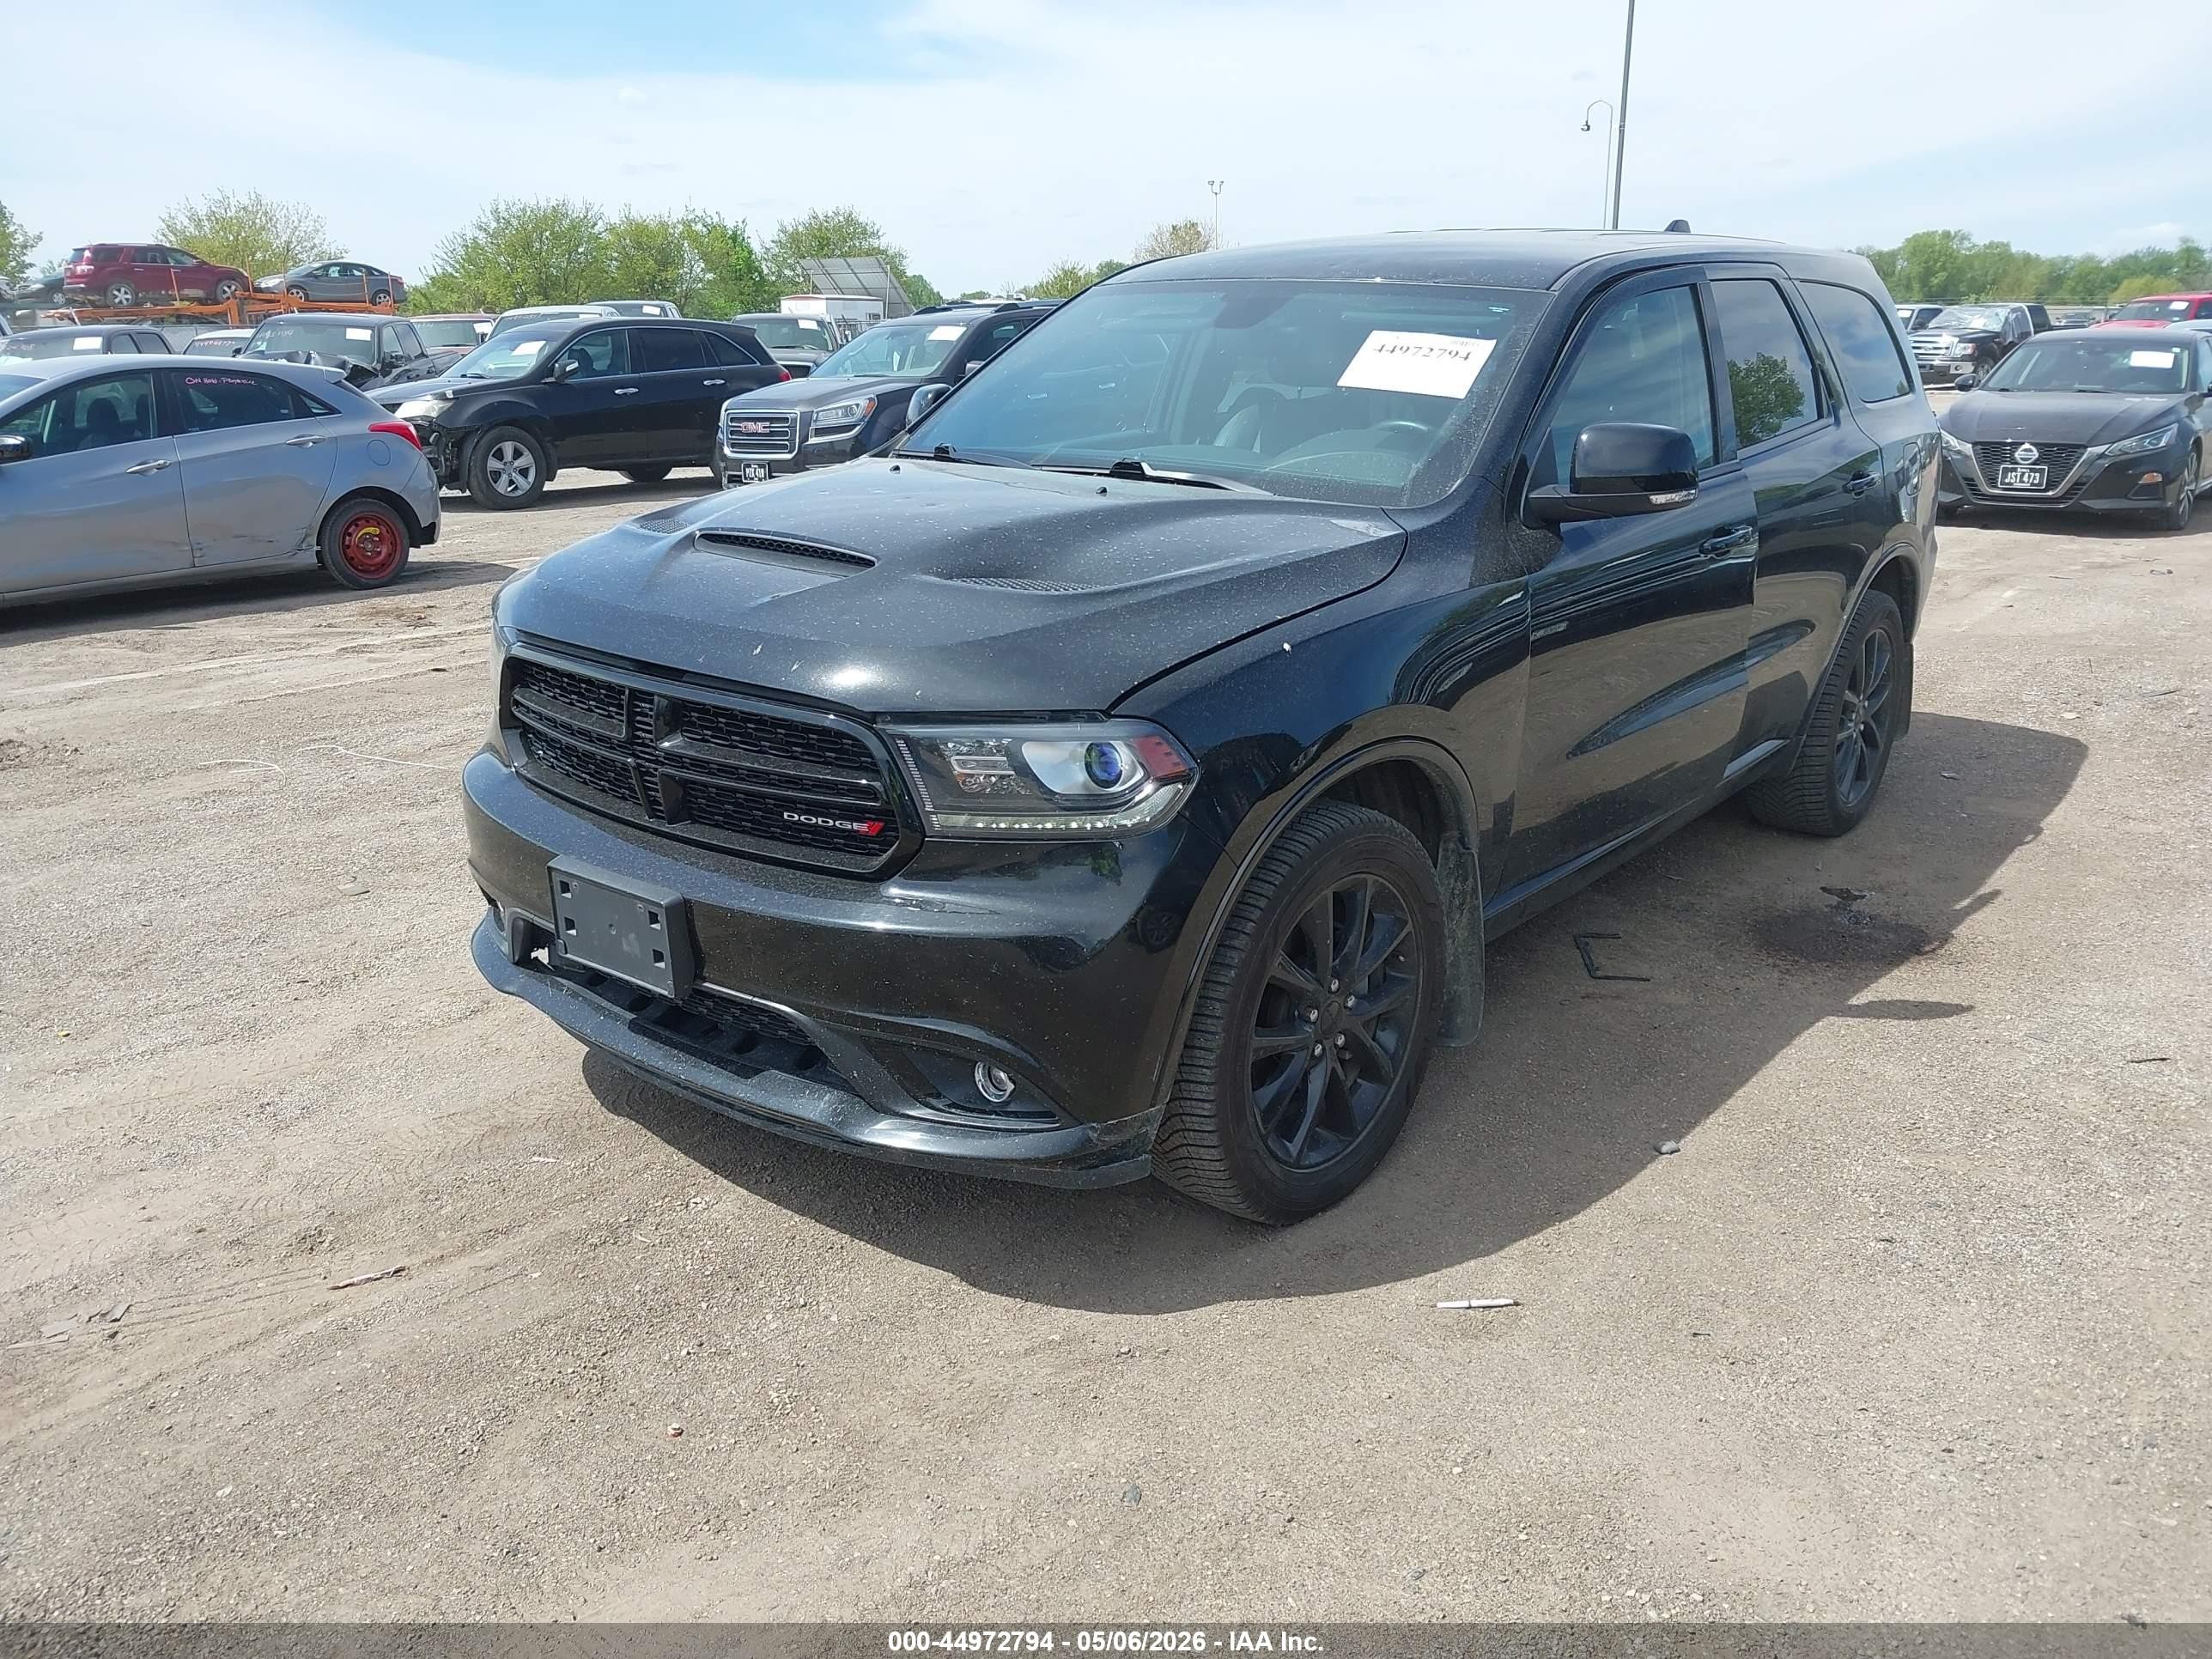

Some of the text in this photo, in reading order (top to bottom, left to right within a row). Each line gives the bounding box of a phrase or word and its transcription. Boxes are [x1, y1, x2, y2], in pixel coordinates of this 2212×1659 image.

[1373, 343, 1472, 362] 44972794
[741, 422, 770, 434] GMC
[2004, 471, 2040, 484] JST 473
[783, 811, 869, 832] DODGE
